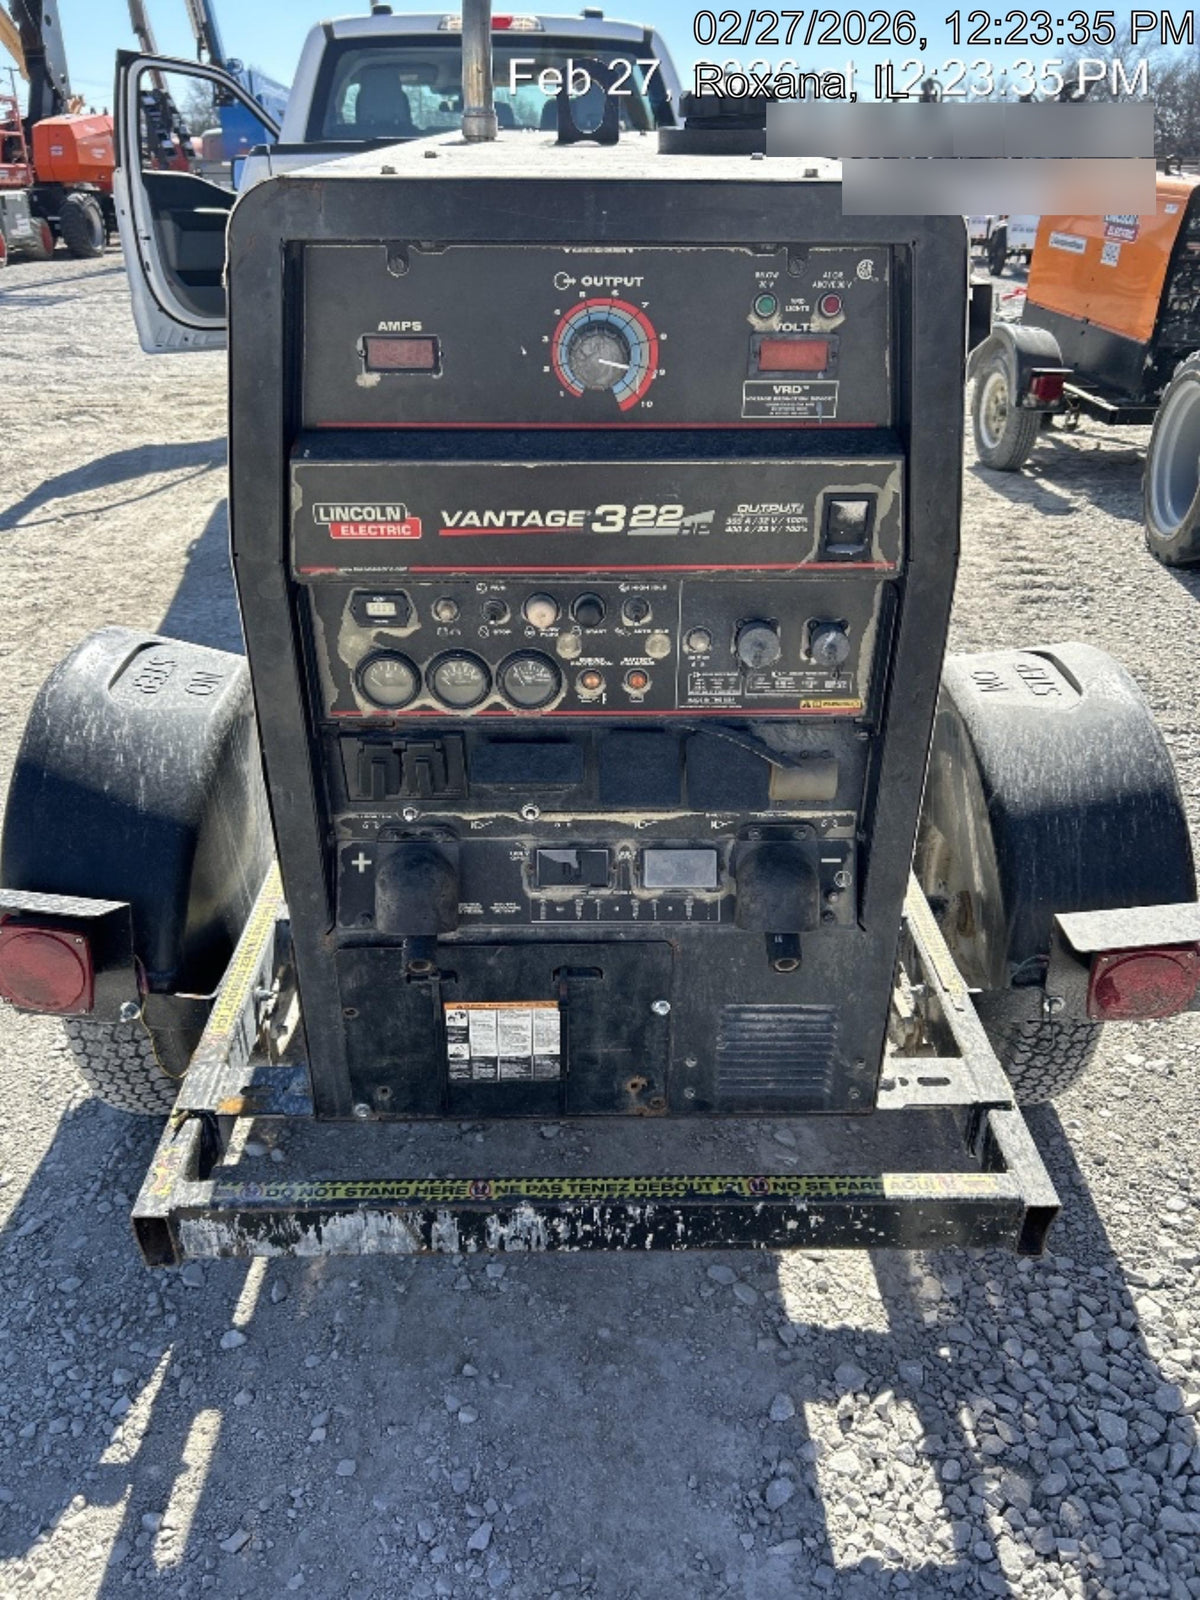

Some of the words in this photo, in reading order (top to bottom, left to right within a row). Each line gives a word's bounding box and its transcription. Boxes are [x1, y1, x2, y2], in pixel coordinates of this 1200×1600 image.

[580, 275, 645, 288] OUTPUT
[377, 321, 423, 331] AMPS
[319, 505, 402, 521] LINCOLN
[441, 510, 584, 527] VANTAGE
[592, 504, 683, 533] 322
[340, 525, 412, 536] ELECTRIC
[265, 1187, 293, 1197] DO
[300, 1186, 341, 1197] NOT
[343, 1185, 410, 1197] STAND
[415, 1185, 469, 1196] HERE
[494, 1185, 521, 1195] NE
[525, 1184, 563, 1194] PAS
[567, 1183, 630, 1194] TENEZ
[634, 1181, 714, 1193] DEBOUT
[773, 1181, 800, 1191] NO
[805, 1181, 831, 1191] SE
